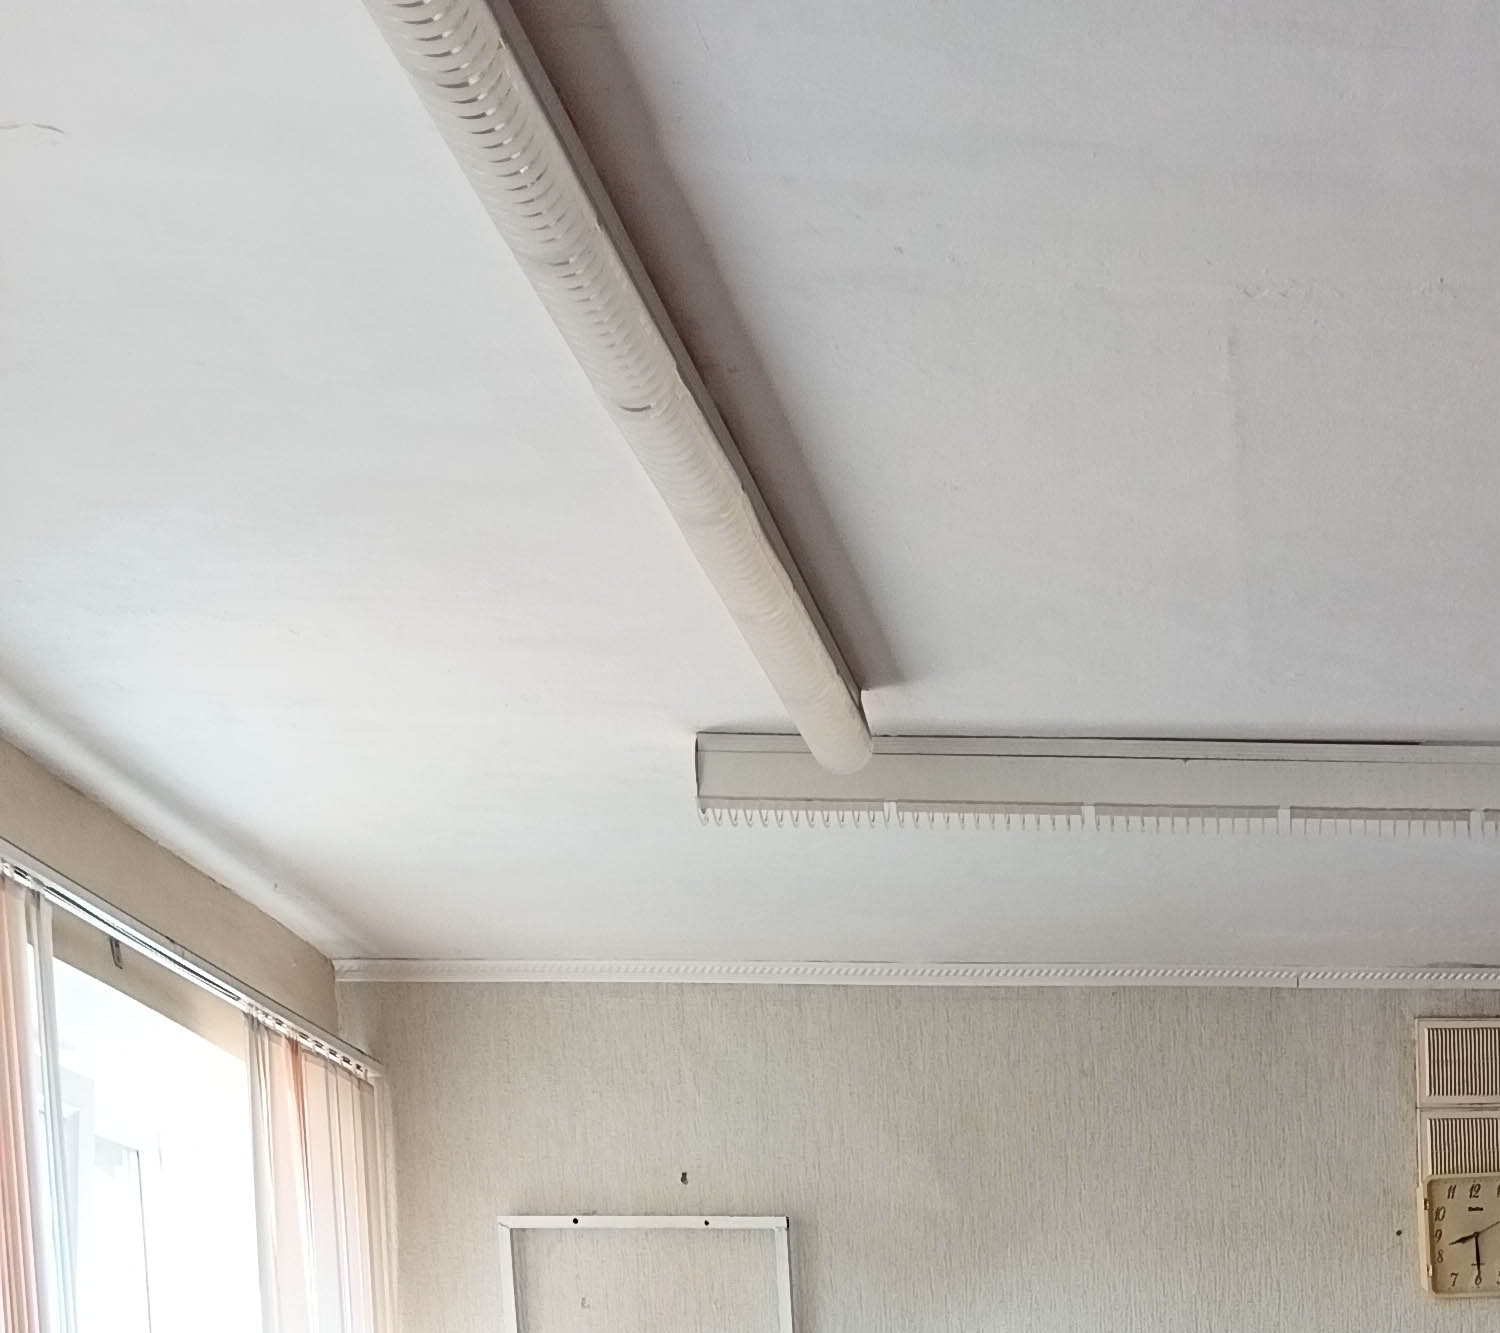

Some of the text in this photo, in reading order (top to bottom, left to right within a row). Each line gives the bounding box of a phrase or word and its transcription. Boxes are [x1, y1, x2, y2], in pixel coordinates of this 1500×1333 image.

[1447, 1184, 1457, 1199] 11
[1469, 1183, 1481, 1198] 12
[1434, 1206, 1446, 1221] 10
[1435, 1228, 1442, 1242] 9
[1436, 1249, 1444, 1263] 8
[1450, 1272, 1459, 1286] 7
